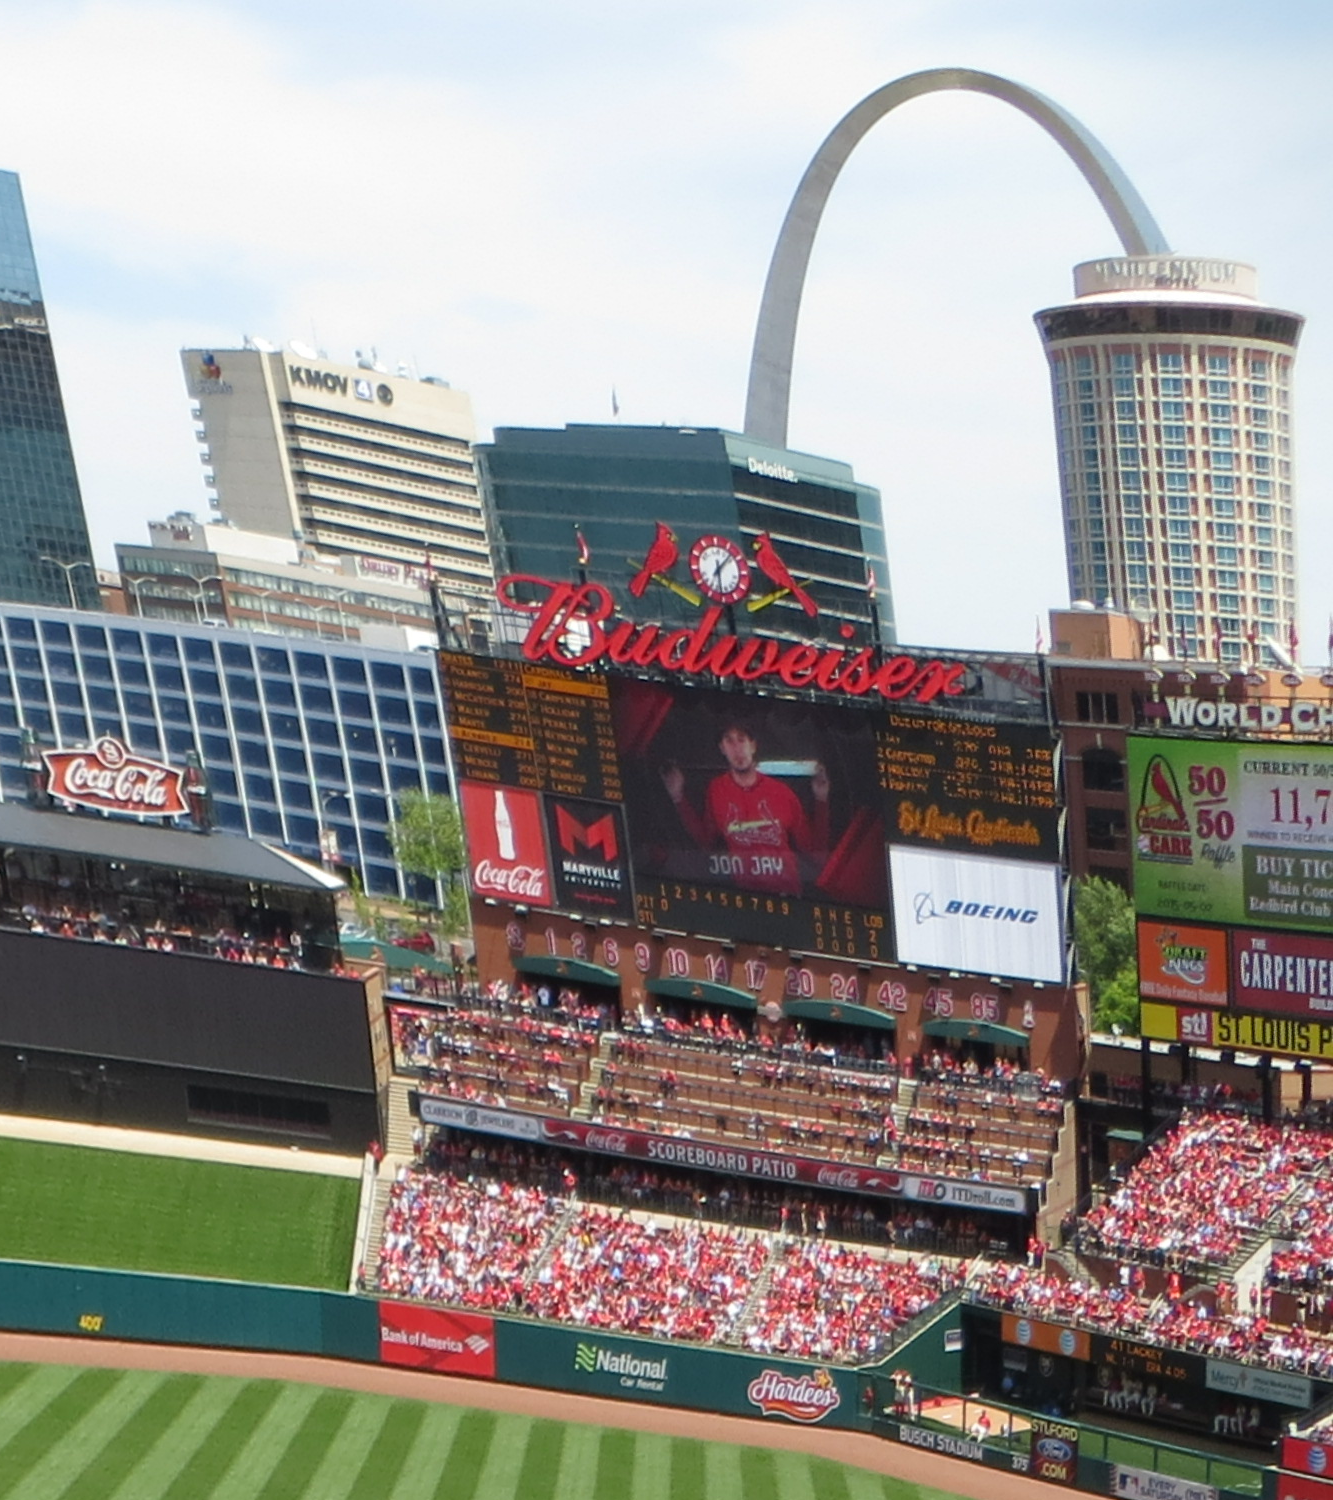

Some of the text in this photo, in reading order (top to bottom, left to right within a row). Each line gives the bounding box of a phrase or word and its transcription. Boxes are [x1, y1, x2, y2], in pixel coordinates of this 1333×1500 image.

[289, 364, 348, 396] KMOV
[495, 573, 966, 703] Budweiser
[1165, 696, 1283, 730] WORLD
[1243, 760, 1308, 776] CURRENT
[64, 758, 167, 806] Coca-Cola
[1188, 765, 1226, 798] 50
[1270, 787, 1331, 831] 11,7
[1196, 809, 1235, 841] 50
[709, 855, 783, 876] JON JAY
[1200, 843, 1235, 870] Raffle
[1256, 856, 1295, 877] BUY
[474, 860, 544, 897] Coca-Cola
[563, 861, 621, 881] MARYVILLE
[1268, 880, 1299, 896] Main
[660, 884, 665, 897] 1
[674, 885, 682, 899] 2
[704, 891, 712, 904] 4
[720, 893, 728, 906] 5
[735, 895, 743, 908] 6
[751, 898, 758, 911] 7
[814, 907, 821, 920] R
[844, 911, 852, 924] E
[945, 899, 1039, 924] BOEING
[1250, 896, 1331, 917] Redbird Club
[636, 894, 655, 909] PIT
[660, 898, 669, 911] 0
[815, 923, 823, 935] 0
[869, 930, 877, 942] 2
[638, 909, 657, 925] STL
[1164, 946, 1208, 960] DRAFT
[1251, 937, 1267, 950] THE
[542, 927, 559, 956] 1
[602, 937, 620, 966] 6
[635, 942, 651, 972] 9
[665, 946, 689, 977] 10
[704, 952, 729, 984] 14
[745, 959, 769, 991] 17
[784, 967, 815, 997] 20
[831, 973, 860, 1001] 24
[877, 981, 907, 1011] 42
[923, 987, 954, 1017] 45
[969, 992, 1000, 1022] 85
[1168, 959, 1204, 972] KINGS
[1182, 1011, 1208, 1035] stl
[1218, 1015, 1310, 1051] ST. LOUIS
[585, 1130, 626, 1153] Coca-Cola
[647, 1139, 797, 1179] SCOREBOARD PATIO
[817, 1167, 859, 1189] Coca-Cola
[381, 1326, 464, 1354] Bank of America
[1111, 1340, 1123, 1353] 41
[1126, 1342, 1164, 1361] LACKEY
[1145, 1361, 1163, 1374] ERA
[1211, 1368, 1240, 1387] Mercy
[619, 1375, 664, 1392] Car Rental
[1033, 1421, 1078, 1442] STLFORD
[899, 1425, 983, 1462] BUSCH STADIUM
[1042, 1442, 1066, 1458] Ford
[1040, 1462, 1066, 1481] .COM
[1148, 1477, 1177, 1492] EVERY
